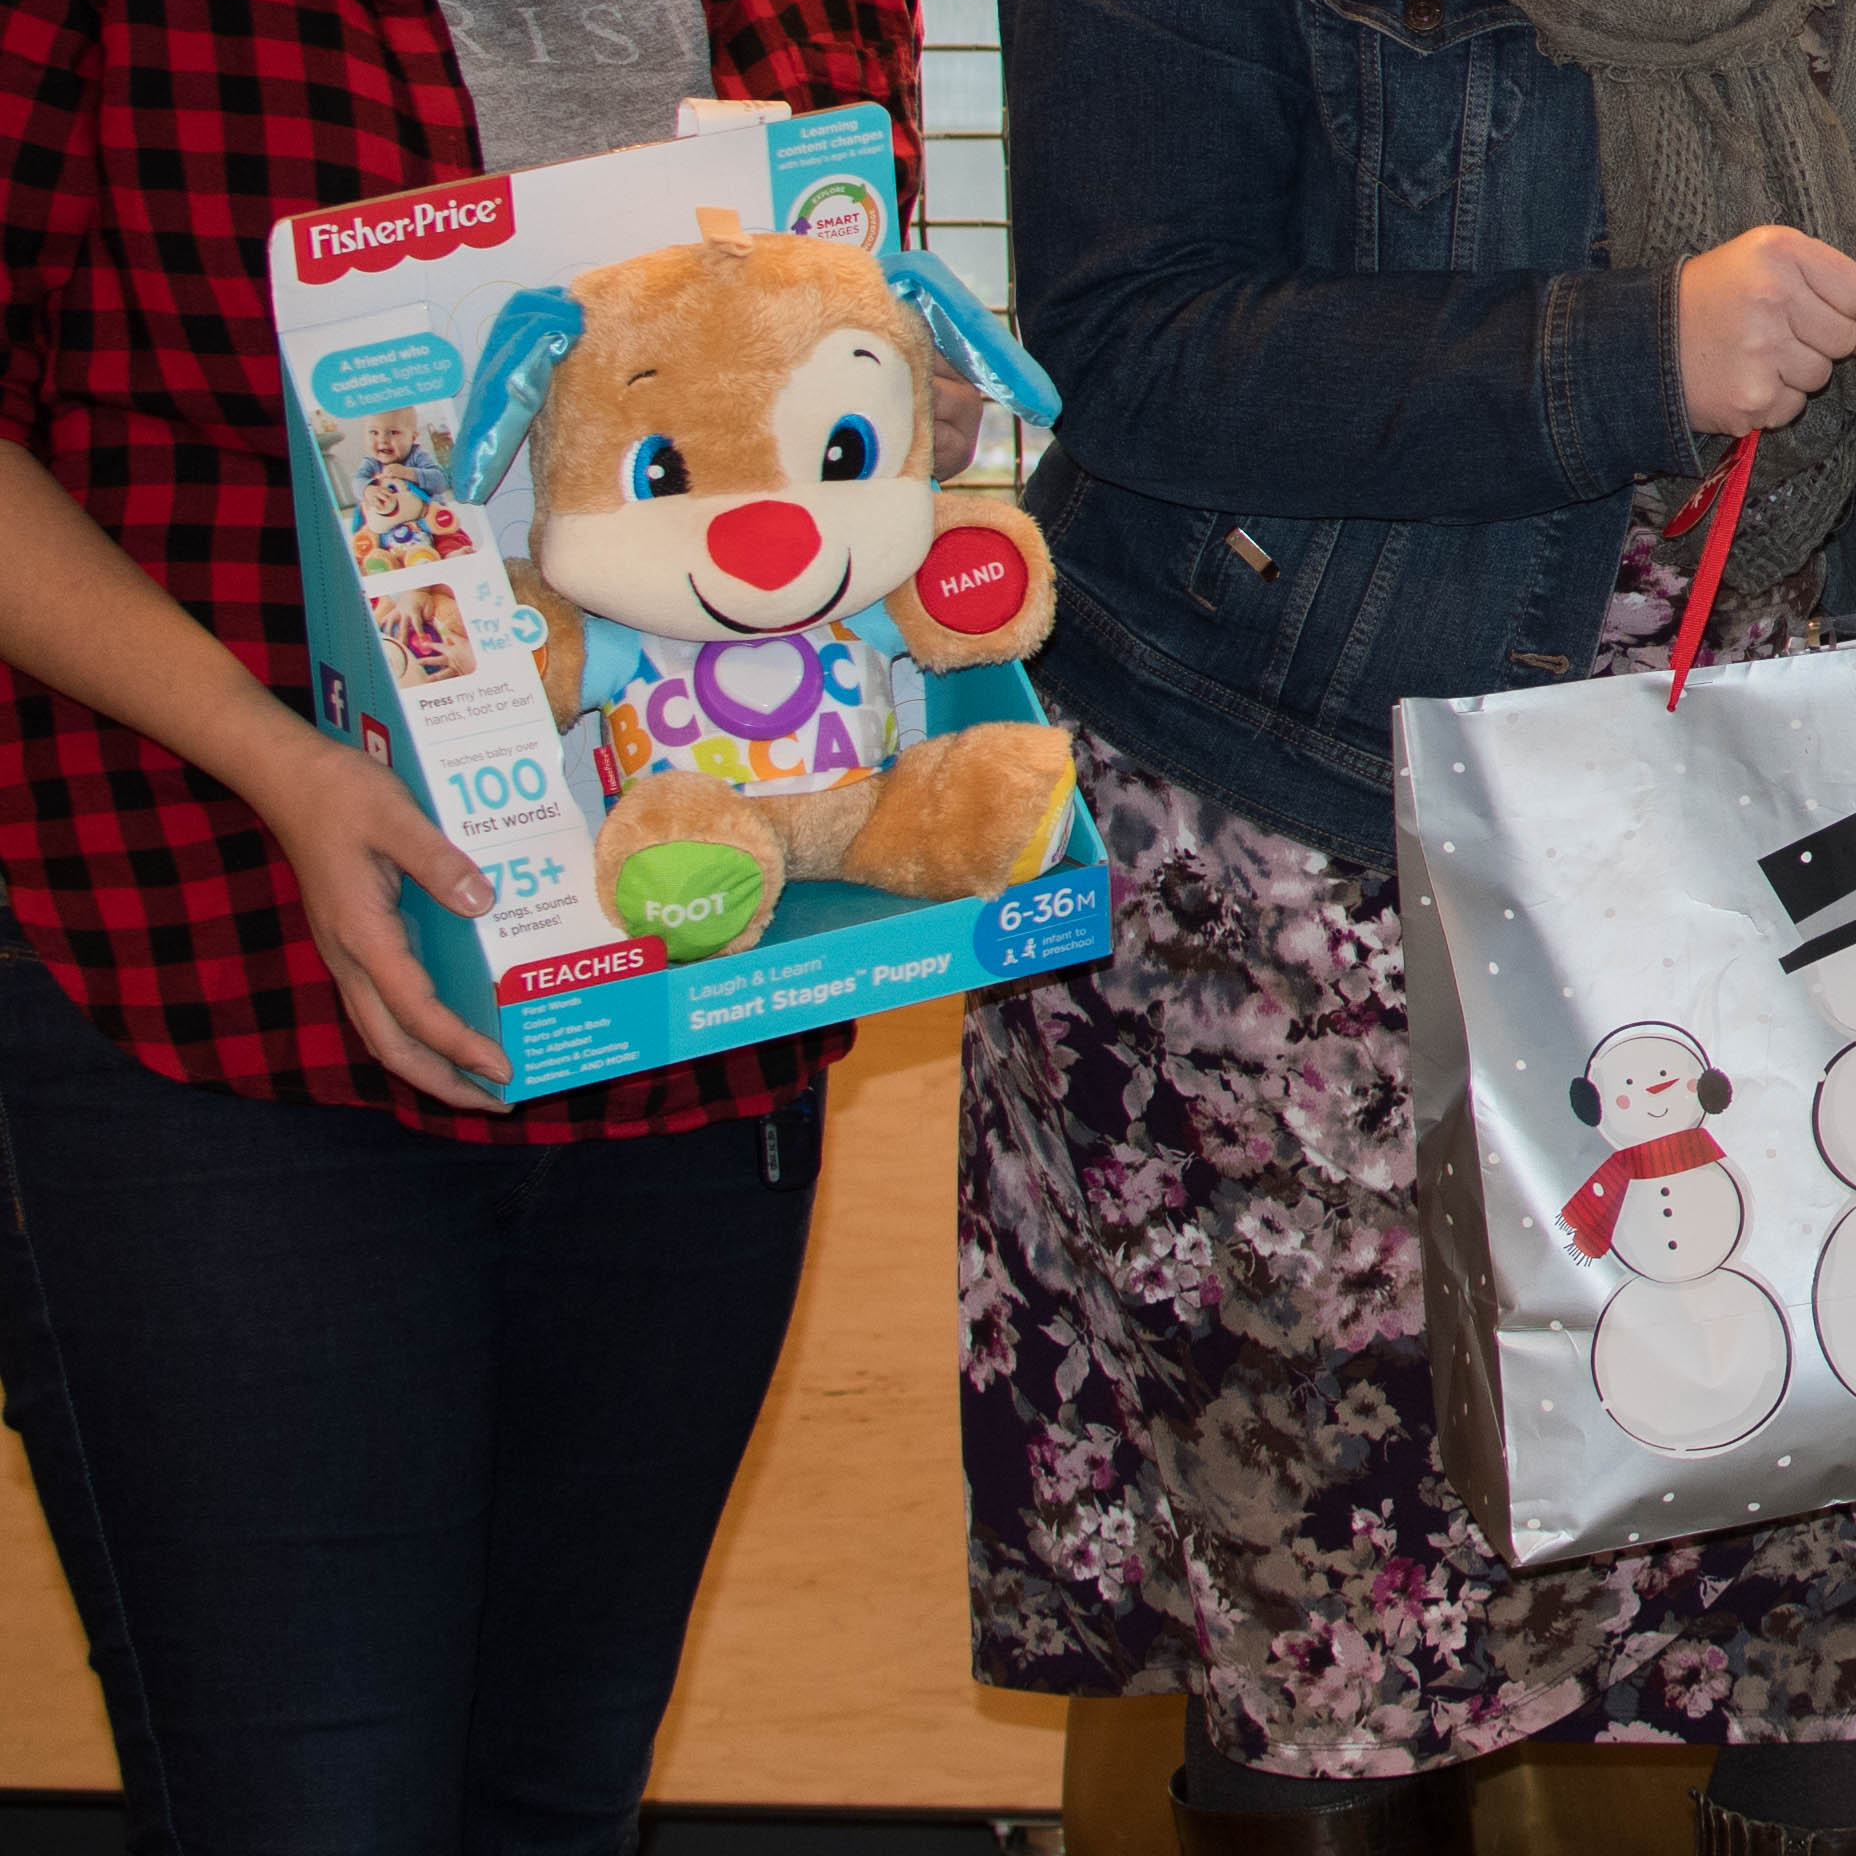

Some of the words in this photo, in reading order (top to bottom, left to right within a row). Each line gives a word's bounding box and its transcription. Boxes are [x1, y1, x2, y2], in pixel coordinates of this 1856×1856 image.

[801, 119, 859, 139] Learning
[776, 138, 828, 159] content
[831, 130, 884, 149] changes
[309, 199, 499, 260] Fisher-Price
[816, 212, 861, 230] SMART
[816, 225, 861, 240] STAGES
[340, 360, 352, 372] A
[353, 350, 397, 370] friend
[398, 345, 430, 360] who
[940, 562, 1006, 598] HAND
[471, 618, 500, 635] Try
[479, 634, 509, 653] Me!
[419, 695, 455, 711] Press
[456, 692, 476, 705] my
[478, 682, 515, 698] heart,
[425, 710, 466, 727] hands,
[467, 703, 493, 719] foot
[495, 700, 509, 711] or
[511, 694, 535, 708] ear!
[440, 751, 484, 769] Teaches
[486, 744, 514, 761] baby
[516, 741, 540, 754] over
[448, 757, 549, 815] 100
[462, 817, 501, 838] first
[502, 802, 563, 828] words!
[481, 856, 566, 905] 75+
[493, 906, 535, 923] songs,
[535, 893, 579, 913] sounds
[645, 891, 729, 928] FOOT
[498, 925, 509, 938] &
[511, 915, 563, 937] phrases!
[1042, 930, 1073, 945] infant
[1075, 927, 1087, 937] to
[1042, 936, 1095, 959] preschool
[521, 948, 645, 992] TEACHES
[689, 974, 748, 1001] Laugh
[752, 969, 766, 986] &
[689, 995, 766, 1031] Smart
[871, 952, 952, 986] Puppy
[521, 1003, 546, 1017] First
[547, 997, 582, 1011] Words
[522, 1016, 557, 1031] Colors
[523, 1030, 551, 1045] Parts
[552, 1028, 564, 1038] of
[565, 1023, 583, 1035] the
[583, 1017, 612, 1031] Body
[524, 1046, 544, 1058] The
[545, 1035, 593, 1054] Alphabet
[524, 1055, 571, 1072] Numbers
[582, 1041, 630, 1059] Counting
[580, 1059, 604, 1073] AND
